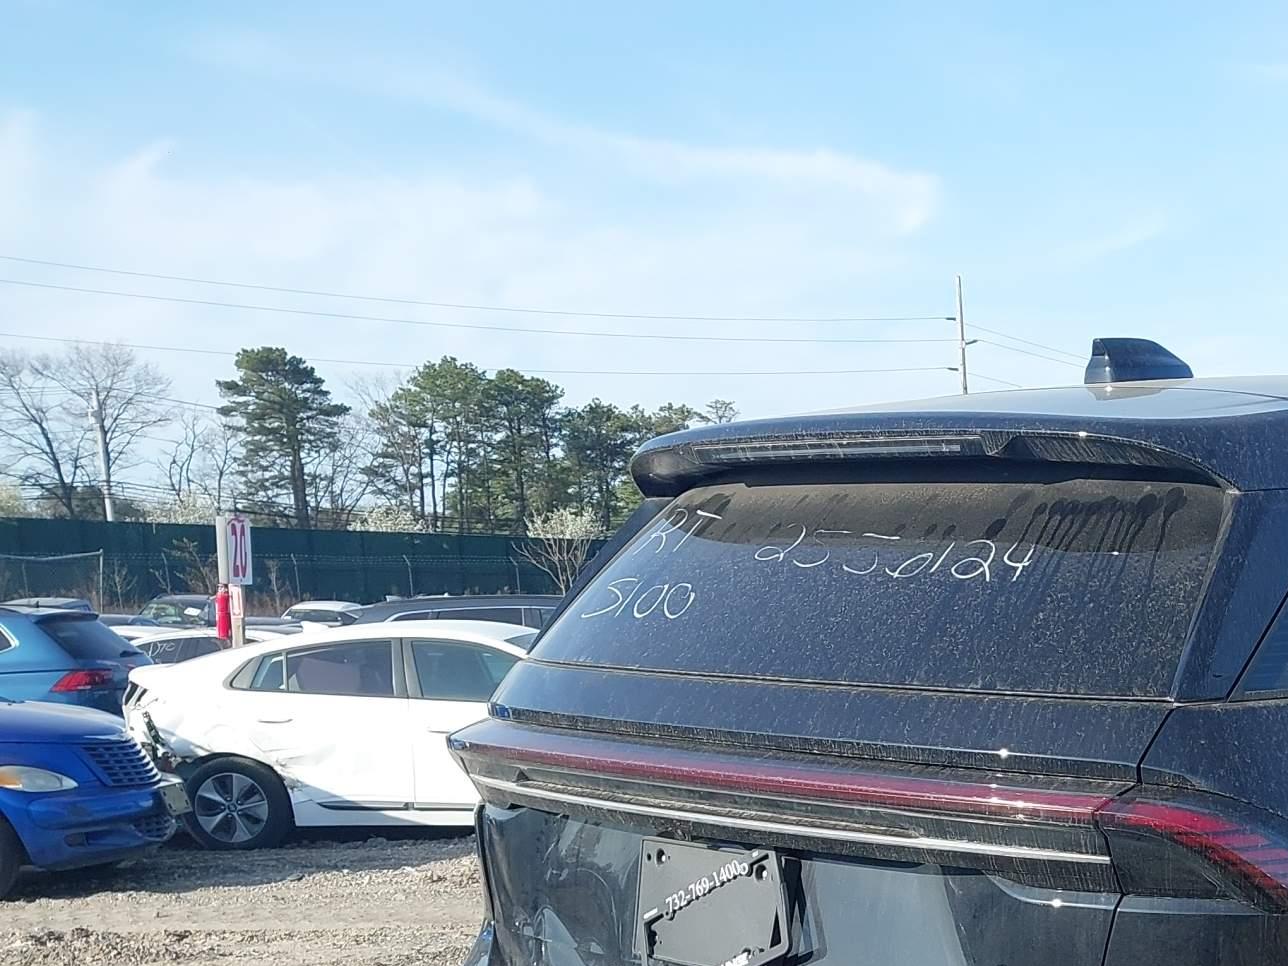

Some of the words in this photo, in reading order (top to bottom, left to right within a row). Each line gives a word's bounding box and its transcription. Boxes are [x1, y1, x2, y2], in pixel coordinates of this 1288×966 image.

[230, 522, 248, 578] 20
[634, 508, 722, 554] RT
[581, 578, 695, 619] S100
[665, 859, 740, 913] 732-769-1400
